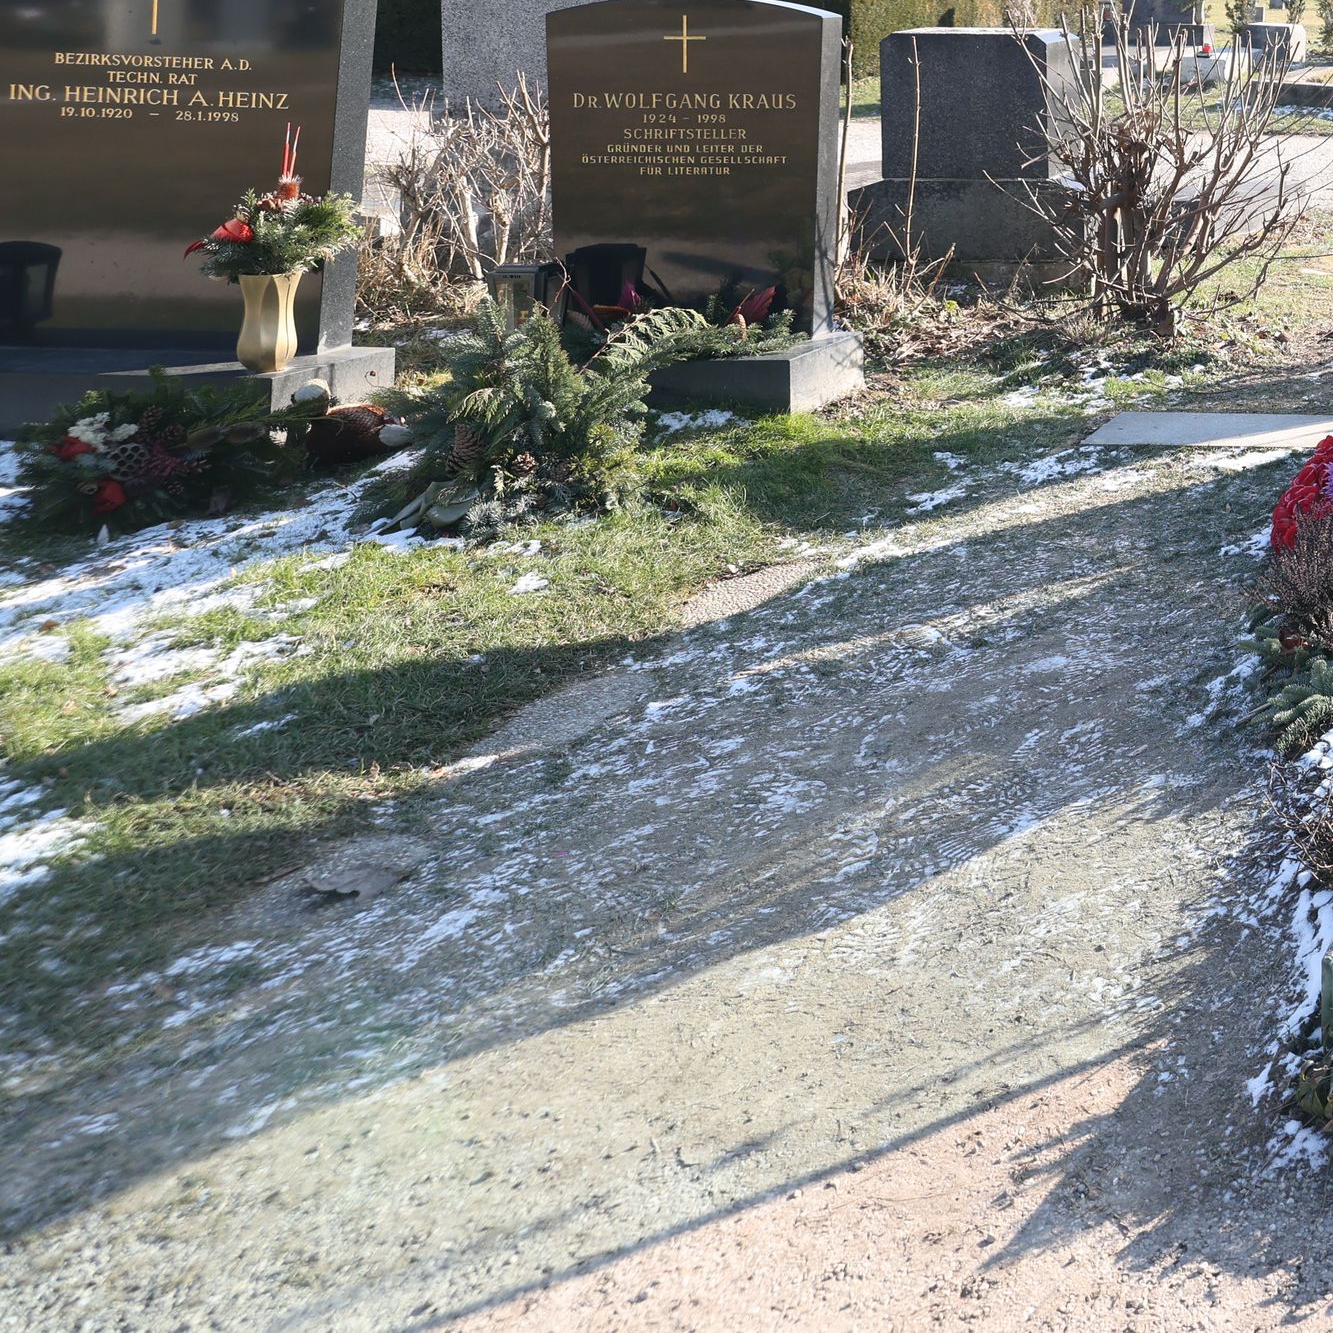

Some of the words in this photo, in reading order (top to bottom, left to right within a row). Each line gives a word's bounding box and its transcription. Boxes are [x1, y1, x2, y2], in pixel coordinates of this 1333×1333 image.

[54, 52, 214, 70] BEZIRKSVORSTEHER
[220, 58, 252, 71] A.D.
[107, 71, 163, 84] TECHN.
[168, 73, 198, 85] RAT
[9, 84, 56, 101] ING.
[64, 86, 179, 106] HEINRICH
[728, 93, 797, 109] KRAUS
[60, 106, 133, 119] 19.10.1920
[175, 110, 239, 123] 28.1.1998
[642, 114, 677, 124] 1924
[697, 114, 727, 124] 1998
[623, 128, 747, 140] SCHRIFTSTELLER
[607, 142, 662, 153] GRÜNDER
[666, 144, 690, 153] UND
[696, 144, 735, 153] LEITER
[741, 144, 764, 153] DER
[581, 153, 695, 164] ÖSTERREICHISCHEN
[700, 155, 787, 165] GESELLSCHAFT
[640, 166, 662, 175] FÜR
[667, 166, 730, 175] LITERATUR
